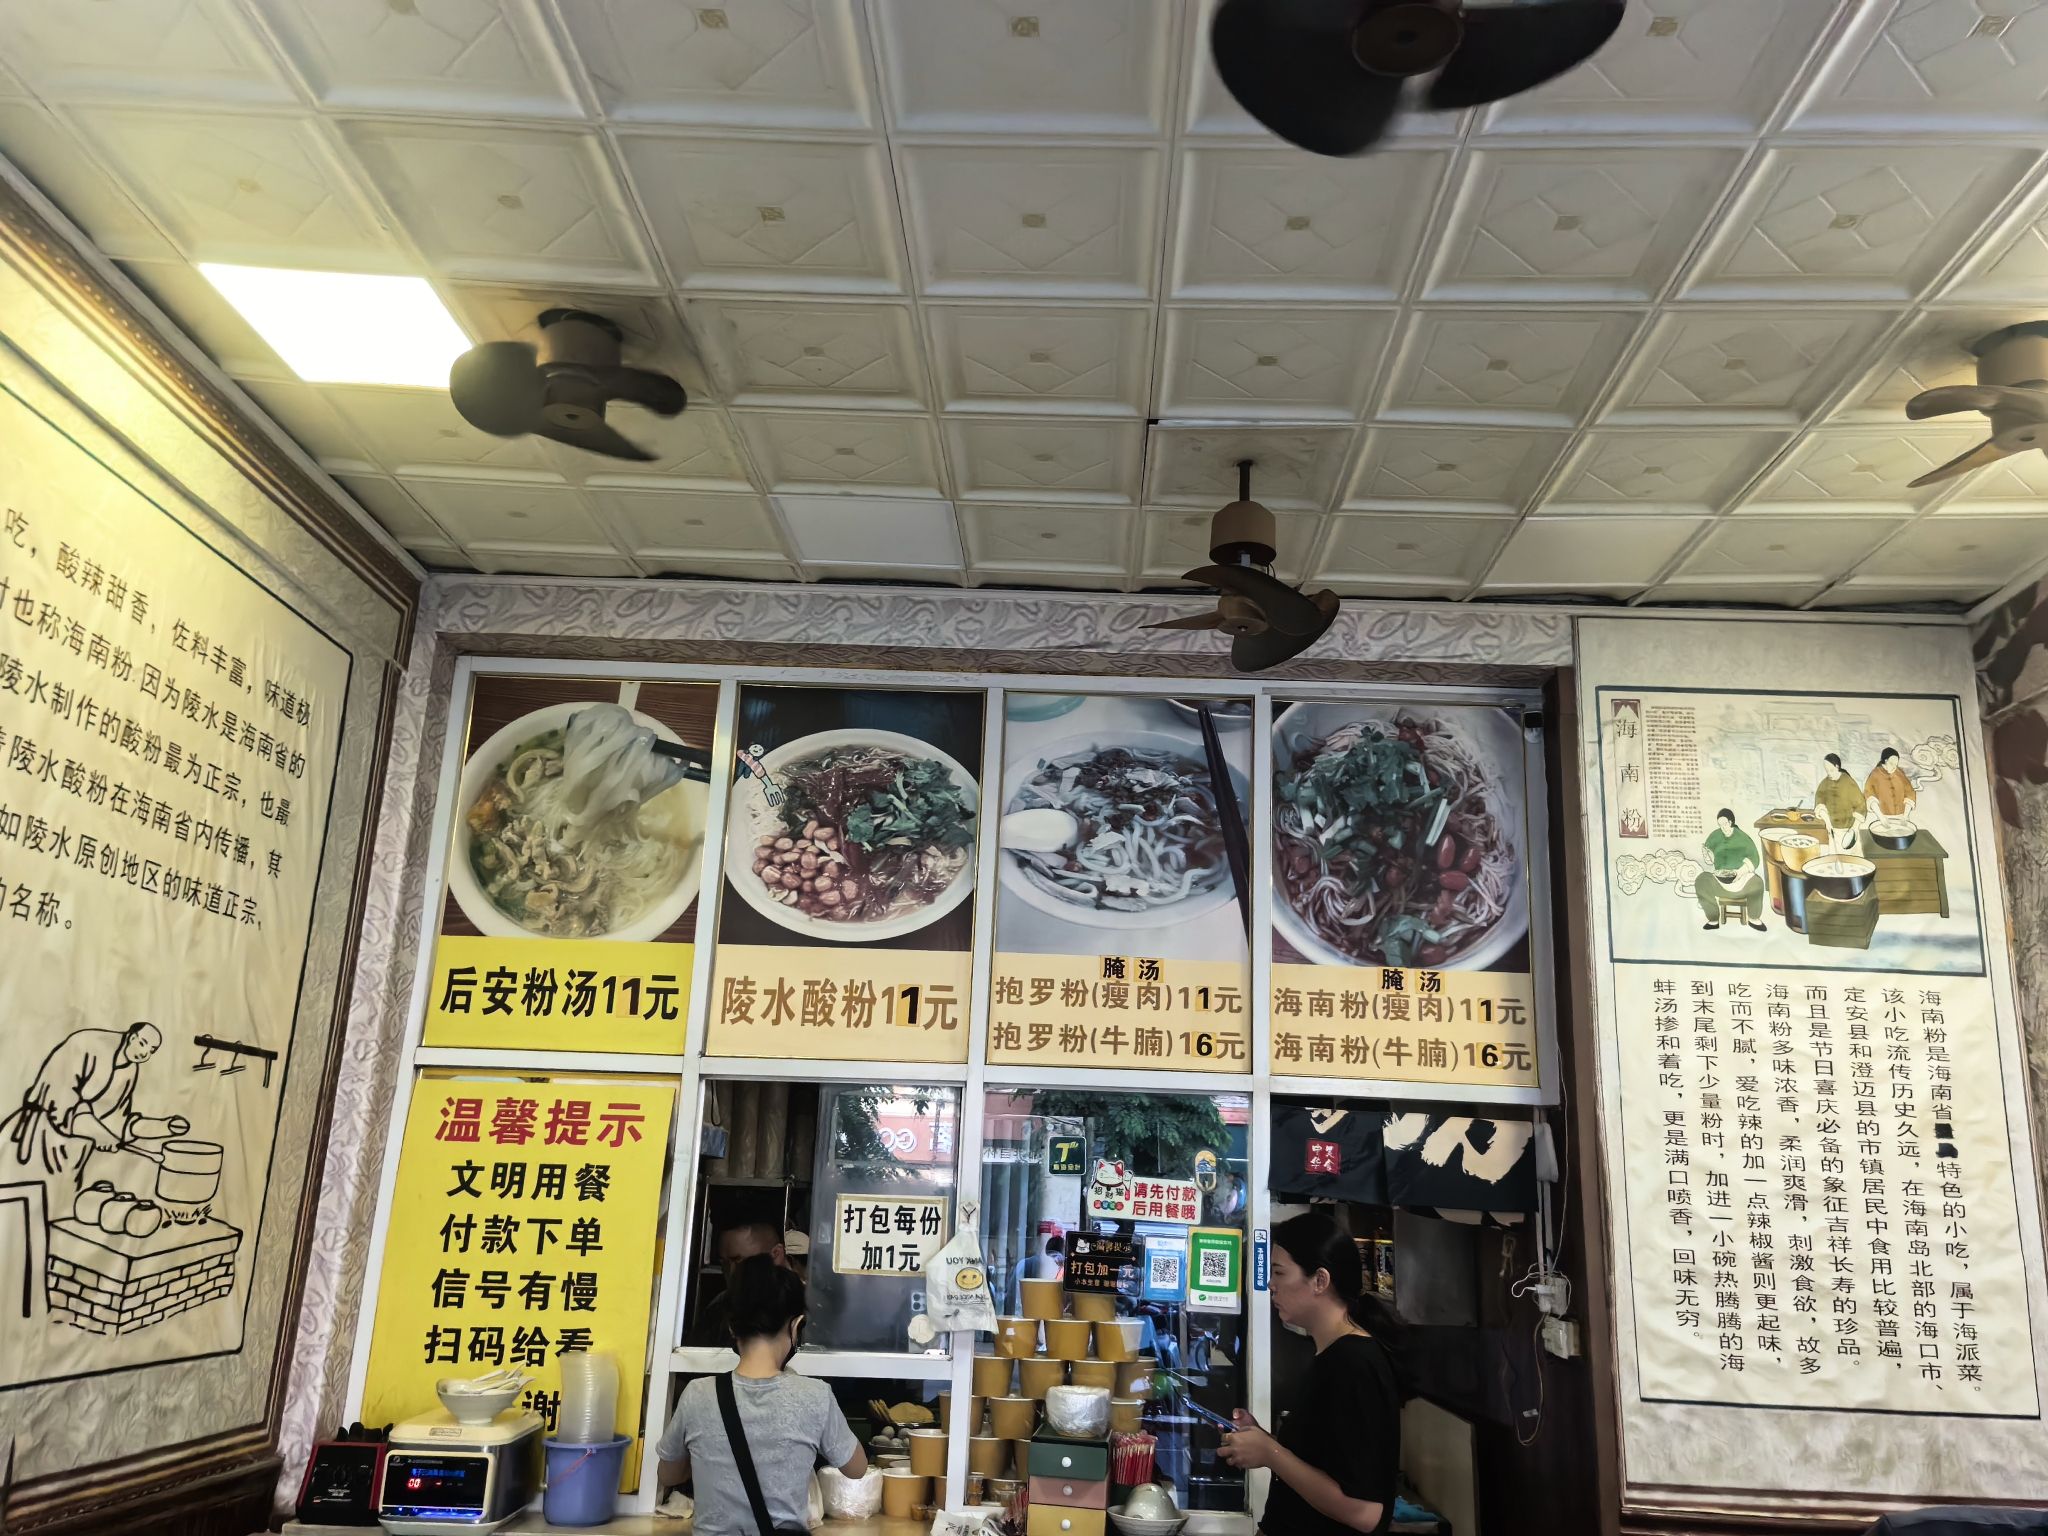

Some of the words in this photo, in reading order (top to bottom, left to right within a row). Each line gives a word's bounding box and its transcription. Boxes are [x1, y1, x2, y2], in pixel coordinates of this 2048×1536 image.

[0, 726, 283, 879] 陵水酸粉在海南省内传播，其
[440, 965, 680, 1021] 后安粉汤11元
[721, 975, 958, 1030] 陵水酸粉11元
[434, 1096, 646, 1147] 温馨提示
[446, 1159, 612, 1202] 文明用餐
[1133, 1181, 1197, 1202] 请先付款
[1919, 989, 1983, 1393] 海南粉是海南省特色的小吃，属于海派菜。
[843, 1204, 942, 1236] 打包每份
[1132, 1201, 1196, 1220] 后用餐哦
[439, 1213, 604, 1257] 付款下单
[862, 1241, 921, 1272] 加1元
[431, 1267, 599, 1312] 信号有慢
[1070, 1260, 1135, 1278] 打包加一元
